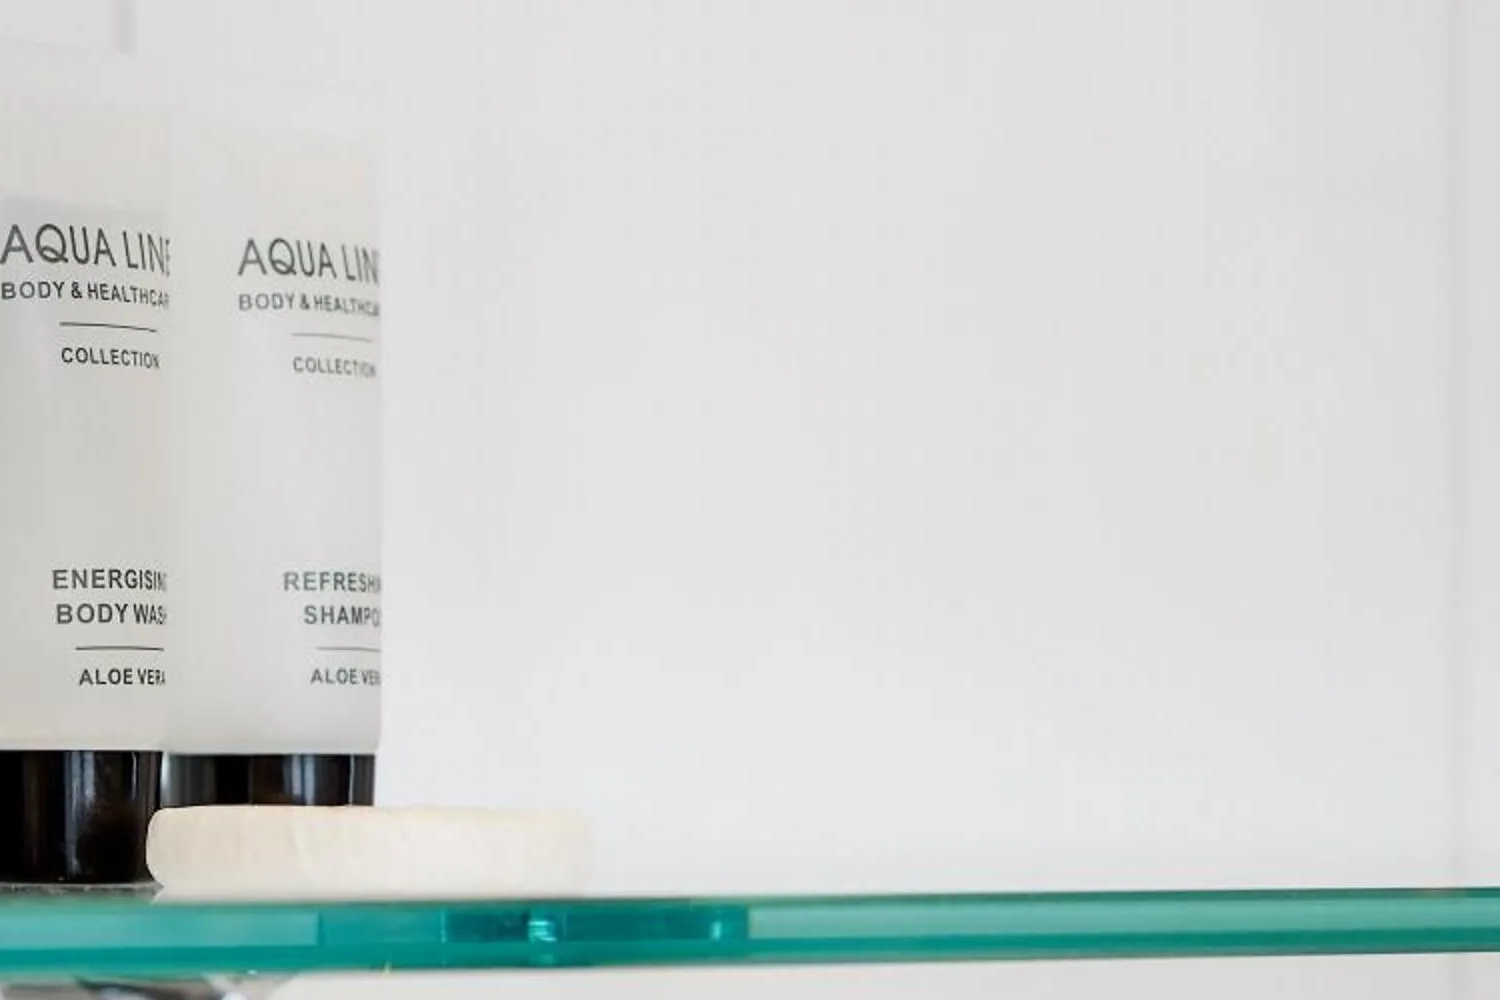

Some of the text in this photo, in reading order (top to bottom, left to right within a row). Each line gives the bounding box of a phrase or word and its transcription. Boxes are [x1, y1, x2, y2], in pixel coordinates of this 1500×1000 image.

[0, 223, 116, 267] AQUA
[238, 237, 338, 279] AQUA
[0, 281, 65, 300] BODY
[71, 281, 83, 299] &
[238, 292, 295, 311] BODY
[300, 293, 311, 310] &
[61, 347, 160, 369] COLLECTION
[52, 568, 167, 592] ENERGISIN
[56, 603, 129, 625] BODY
[79, 668, 134, 686] ALOE
[310, 667, 358, 686] ALOE
